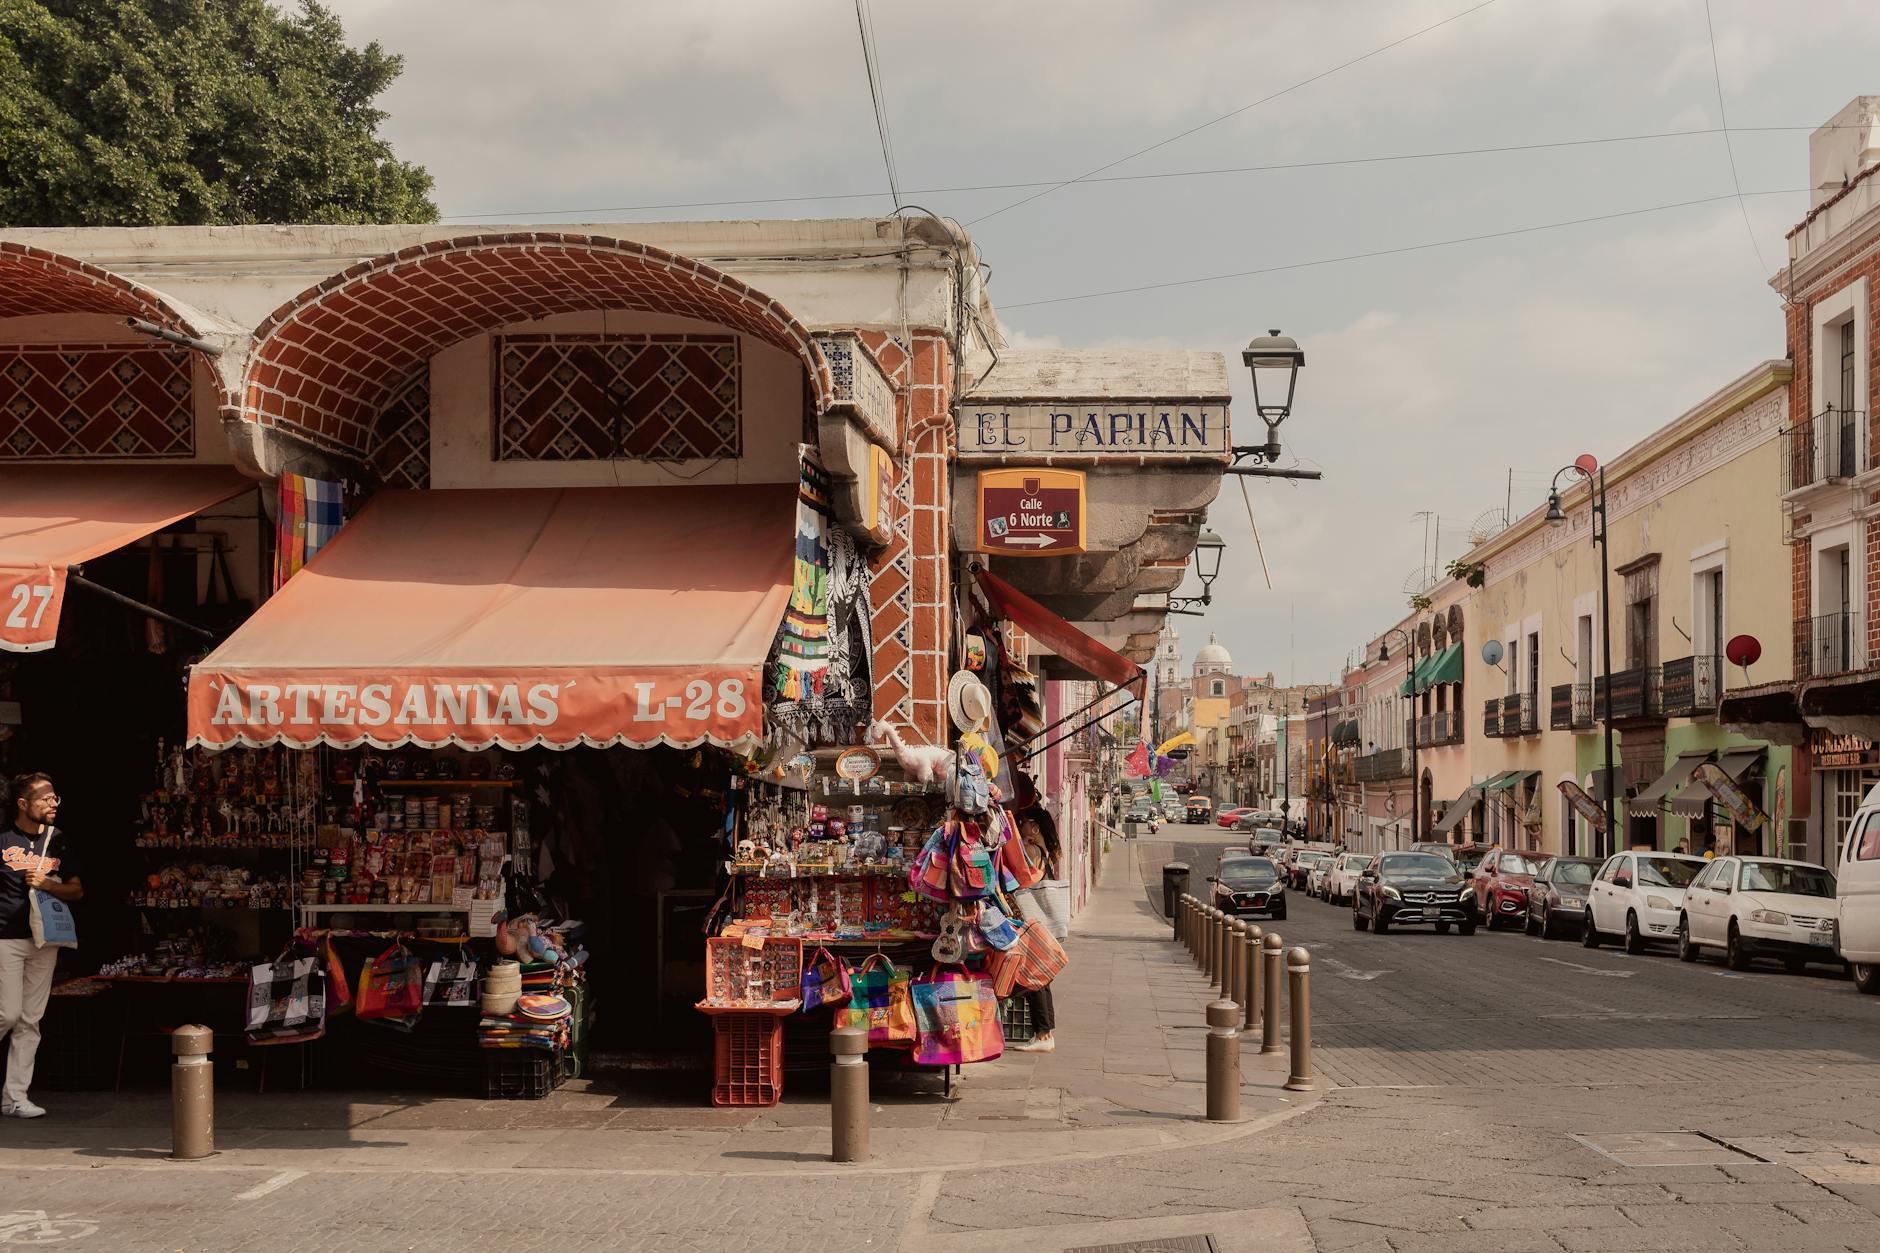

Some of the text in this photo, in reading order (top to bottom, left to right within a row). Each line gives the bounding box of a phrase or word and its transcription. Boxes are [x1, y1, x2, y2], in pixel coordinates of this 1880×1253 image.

[975, 412, 1208, 446] EL PARIAN
[1009, 513, 1053, 527] 6 Norte
[1020, 498, 1043, 510] Calle
[5, 583, 54, 629] 27
[632, 678, 746, 723] L-28
